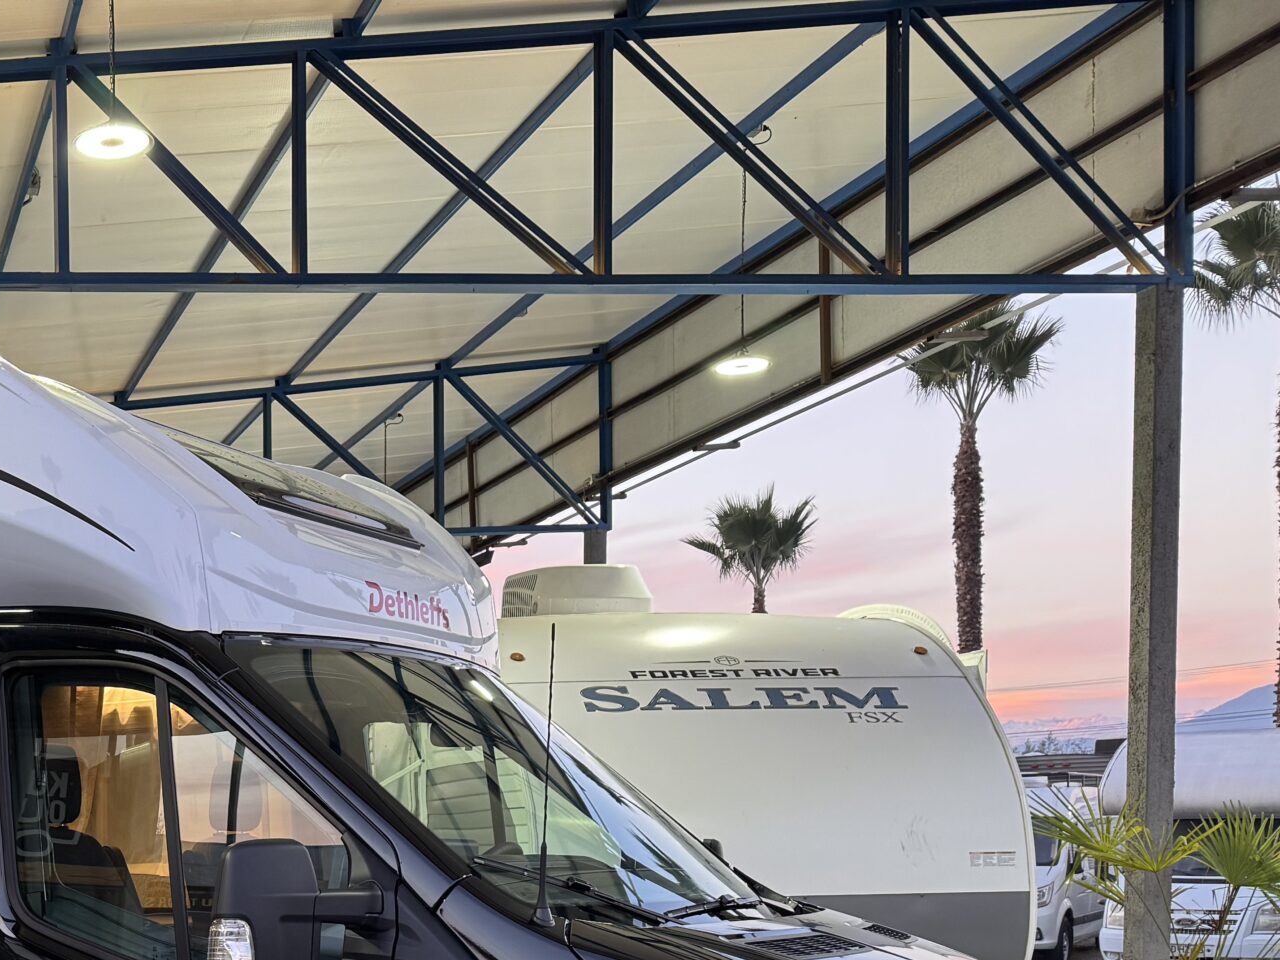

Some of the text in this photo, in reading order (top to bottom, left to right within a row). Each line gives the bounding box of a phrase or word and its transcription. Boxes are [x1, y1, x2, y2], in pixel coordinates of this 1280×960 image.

[365, 580, 450, 629] Dethleffs
[628, 667, 841, 679] FOREST RIVER
[580, 685, 909, 712] SALEM
[846, 711, 904, 724] FSX
